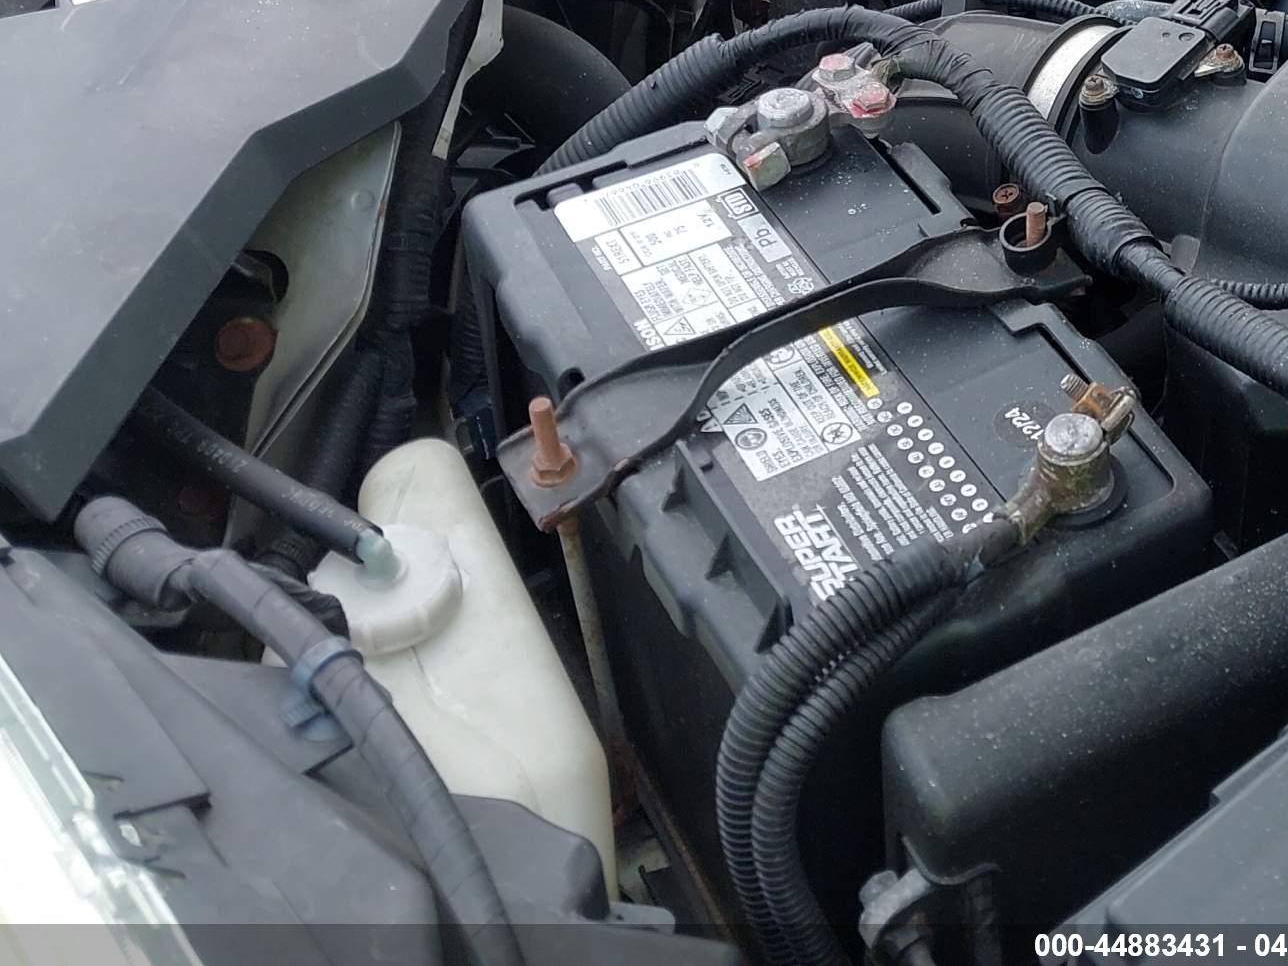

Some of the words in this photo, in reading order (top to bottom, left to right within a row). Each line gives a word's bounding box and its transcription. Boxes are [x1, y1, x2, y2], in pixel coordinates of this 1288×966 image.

[754, 227, 776, 248] Pb
[632, 318, 664, 351] ISON
[774, 512, 836, 601] SUPER
[793, 510, 859, 590] TART
